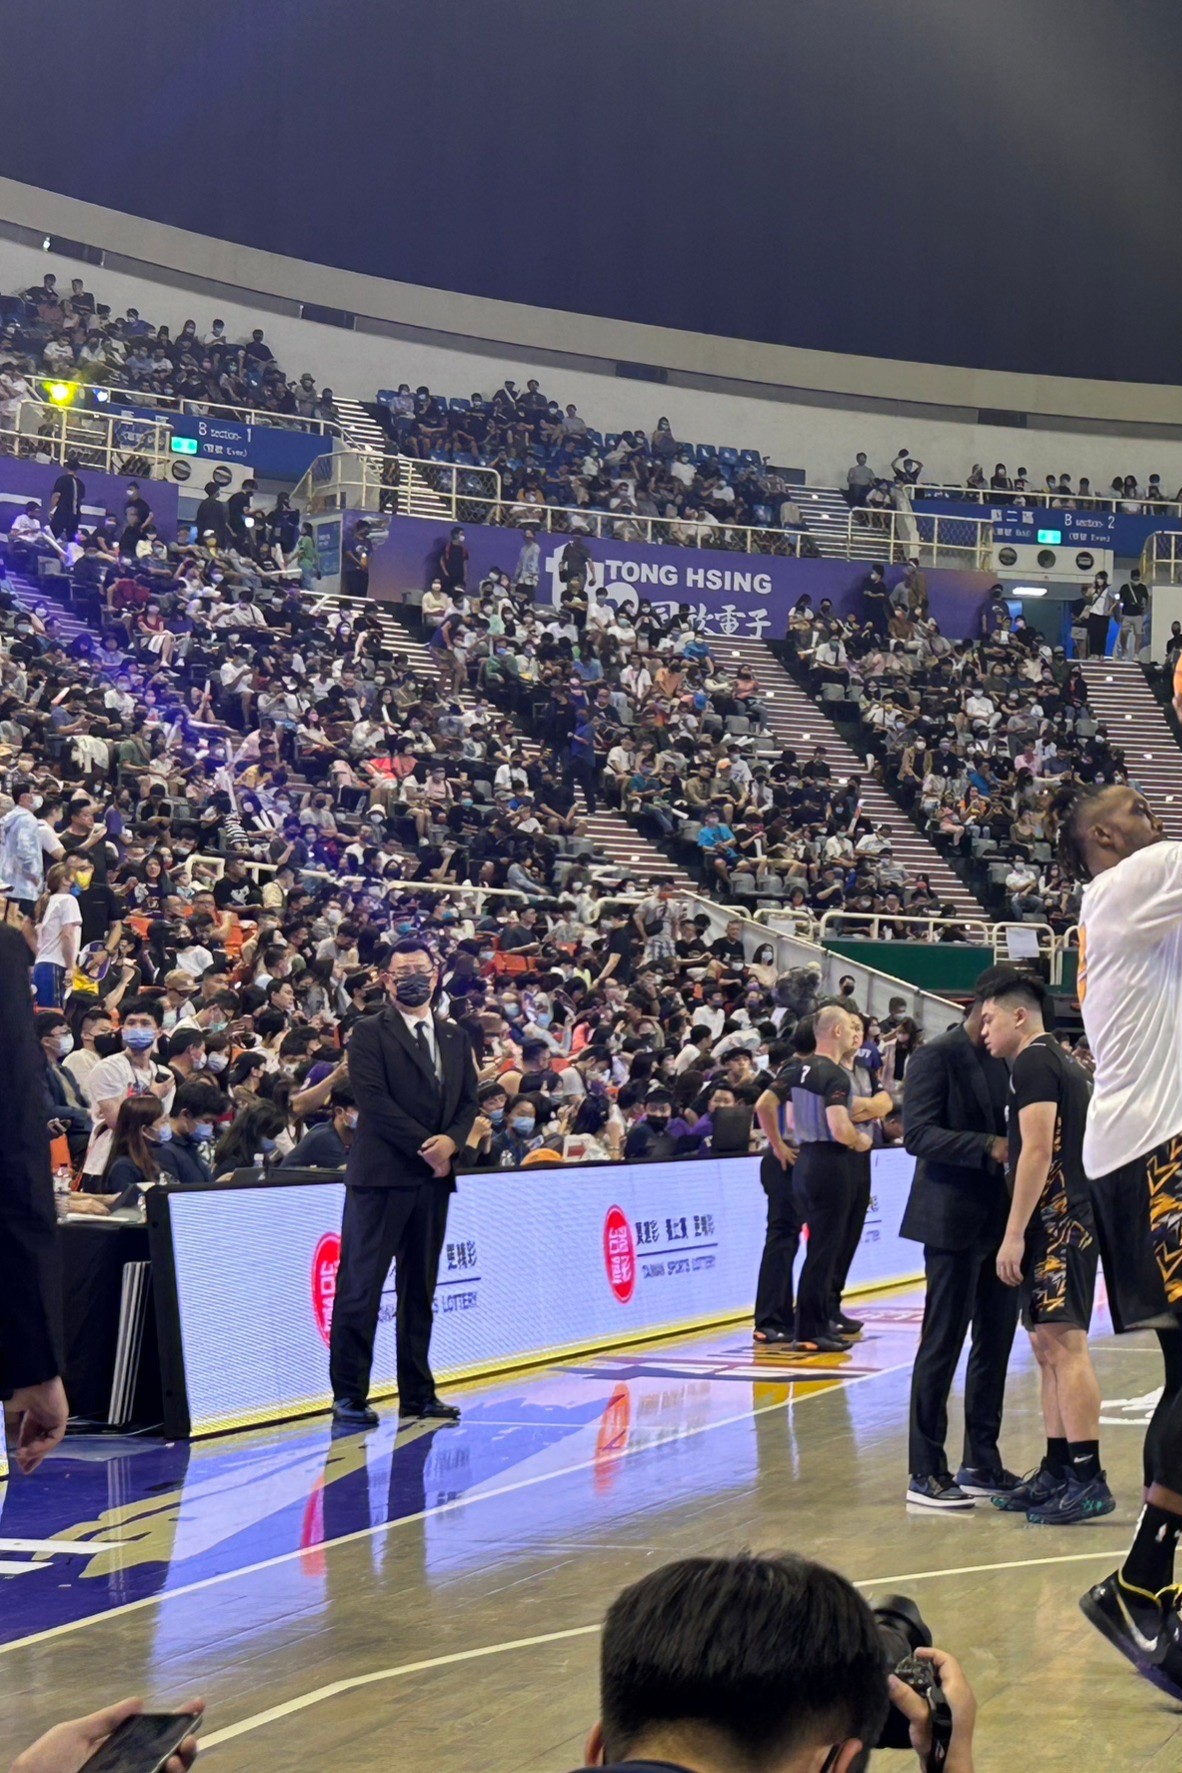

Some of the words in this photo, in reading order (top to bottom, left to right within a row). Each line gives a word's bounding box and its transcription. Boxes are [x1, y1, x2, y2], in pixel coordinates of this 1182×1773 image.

[1107, 515, 1115, 529] 2
[605, 559, 679, 586] TONG
[686, 567, 772, 594] HSING
[800, 1064, 811, 1083] 7
